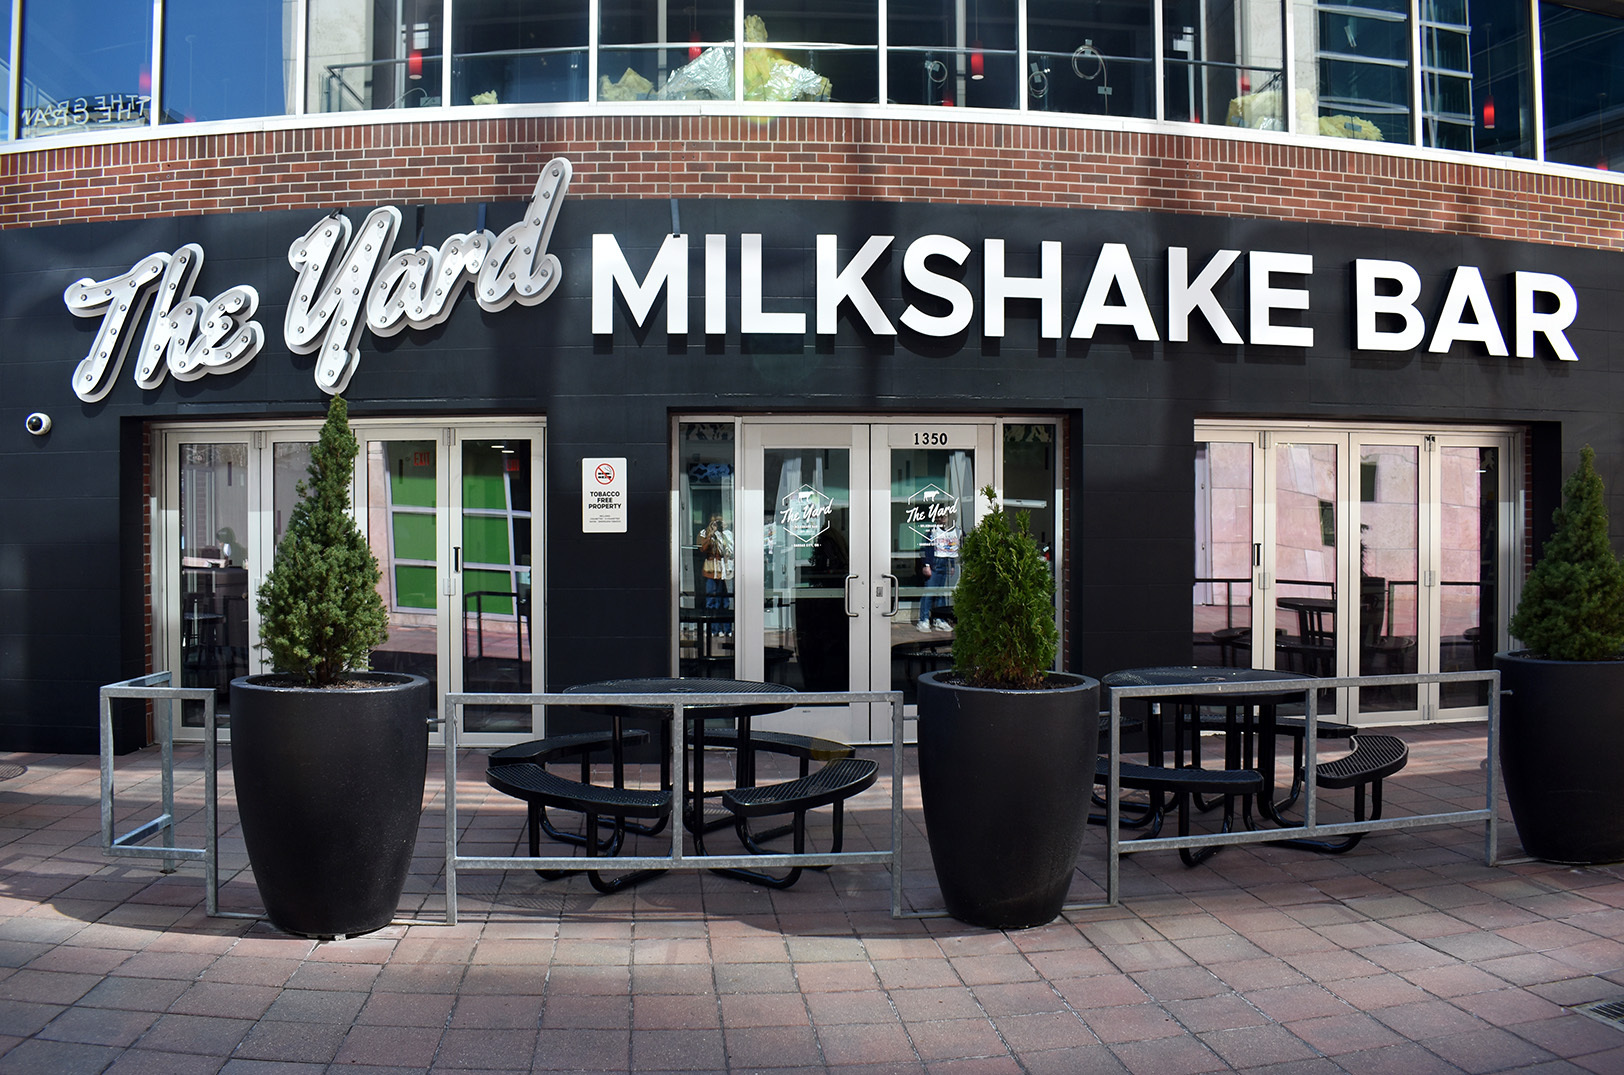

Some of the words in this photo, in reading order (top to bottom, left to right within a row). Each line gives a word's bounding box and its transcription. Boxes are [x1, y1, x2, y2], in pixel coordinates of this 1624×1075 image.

[64, 243, 265, 402] The
[284, 157, 573, 395] Yard
[591, 233, 1314, 348] MILKSHAKE
[1356, 258, 1580, 362] BAR
[913, 432, 948, 446] 1350
[413, 451, 430, 467] EXIT
[779, 507, 801, 524] The
[803, 498, 834, 523] Yard
[905, 506, 926, 524] The
[928, 497, 959, 522] Yard
